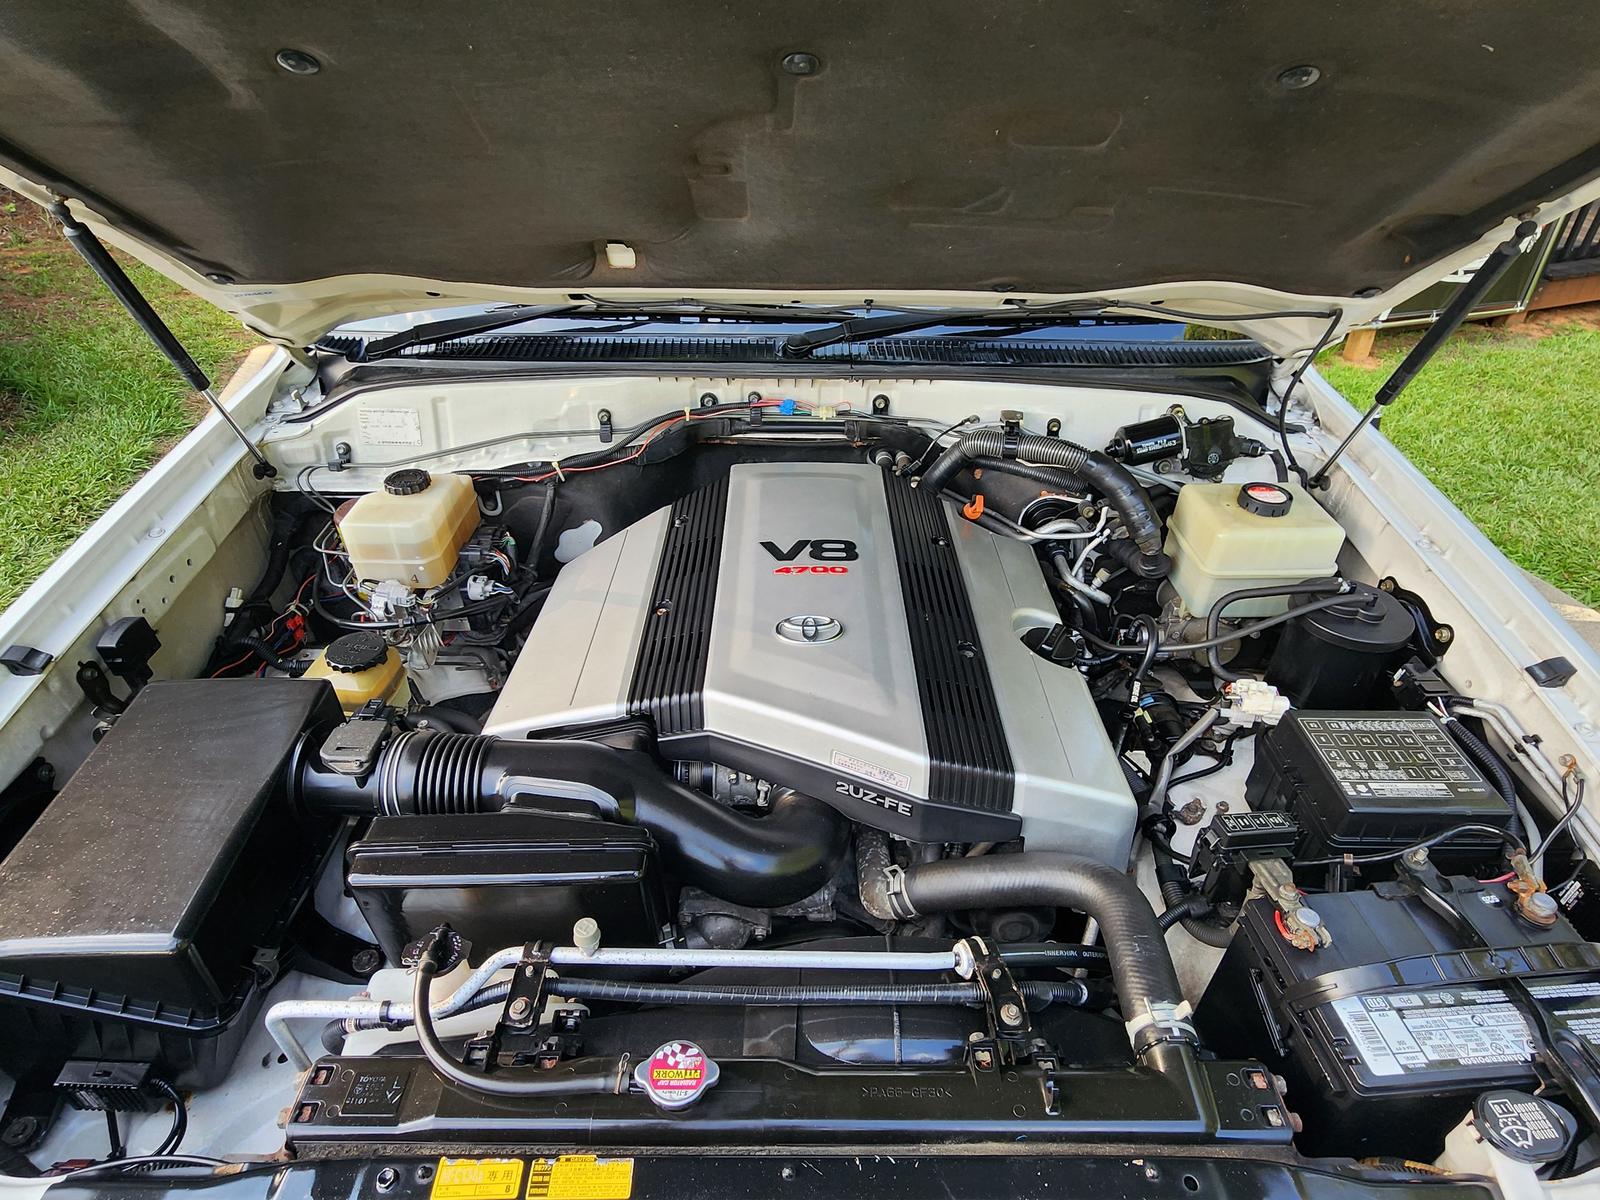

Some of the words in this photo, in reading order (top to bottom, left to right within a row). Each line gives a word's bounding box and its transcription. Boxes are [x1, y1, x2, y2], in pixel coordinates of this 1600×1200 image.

[759, 539, 859, 561] V8
[773, 566, 848, 574] 4700
[835, 782, 913, 817] 2UZ-FE
